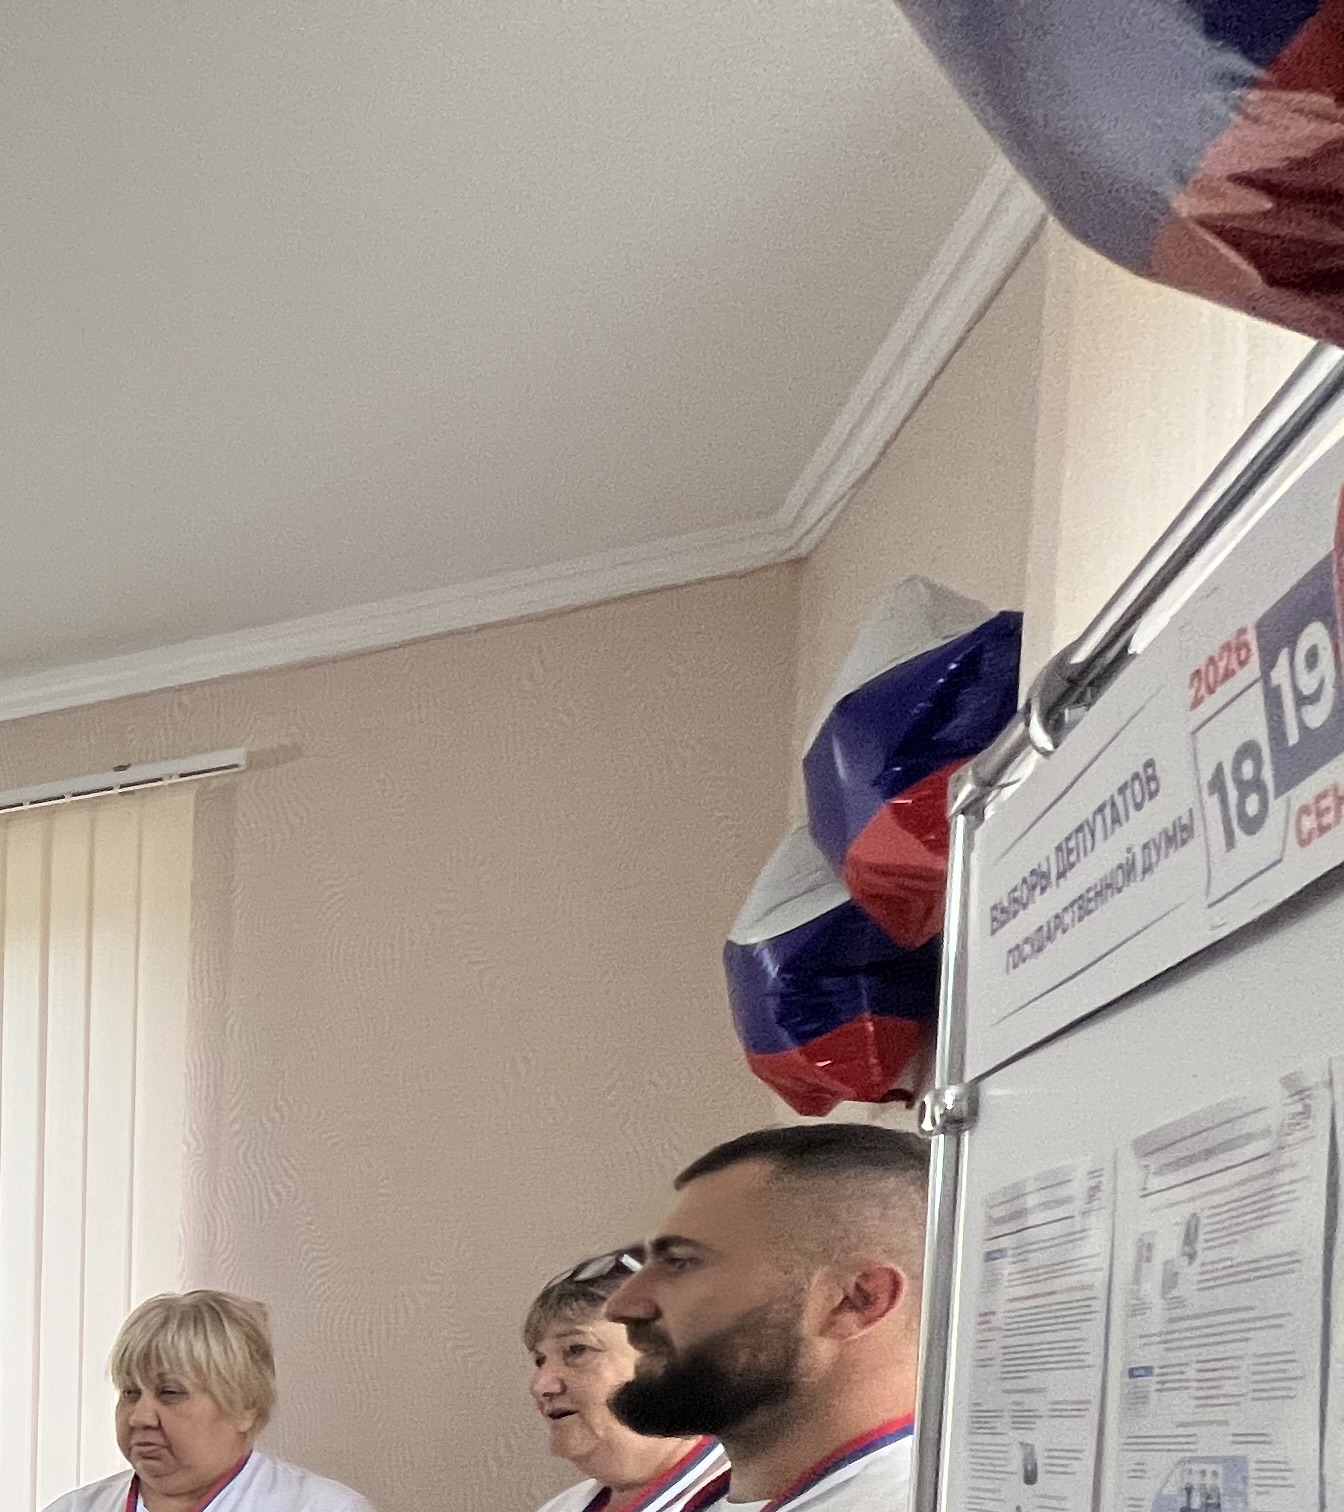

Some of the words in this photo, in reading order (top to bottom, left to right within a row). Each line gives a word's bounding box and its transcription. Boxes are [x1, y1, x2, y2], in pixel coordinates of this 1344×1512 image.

[1189, 624, 1255, 711] 2026
[1207, 738, 1270, 853] 18
[1271, 620, 1337, 747] 19
[989, 855, 1052, 937] ВЫБОРЫ
[1054, 757, 1160, 888] ДЕПУТАТОВ
[1006, 845, 1137, 975] ГОСУДАРСТВЕННОЙ
[1141, 807, 1195, 882] ДУМЫ
